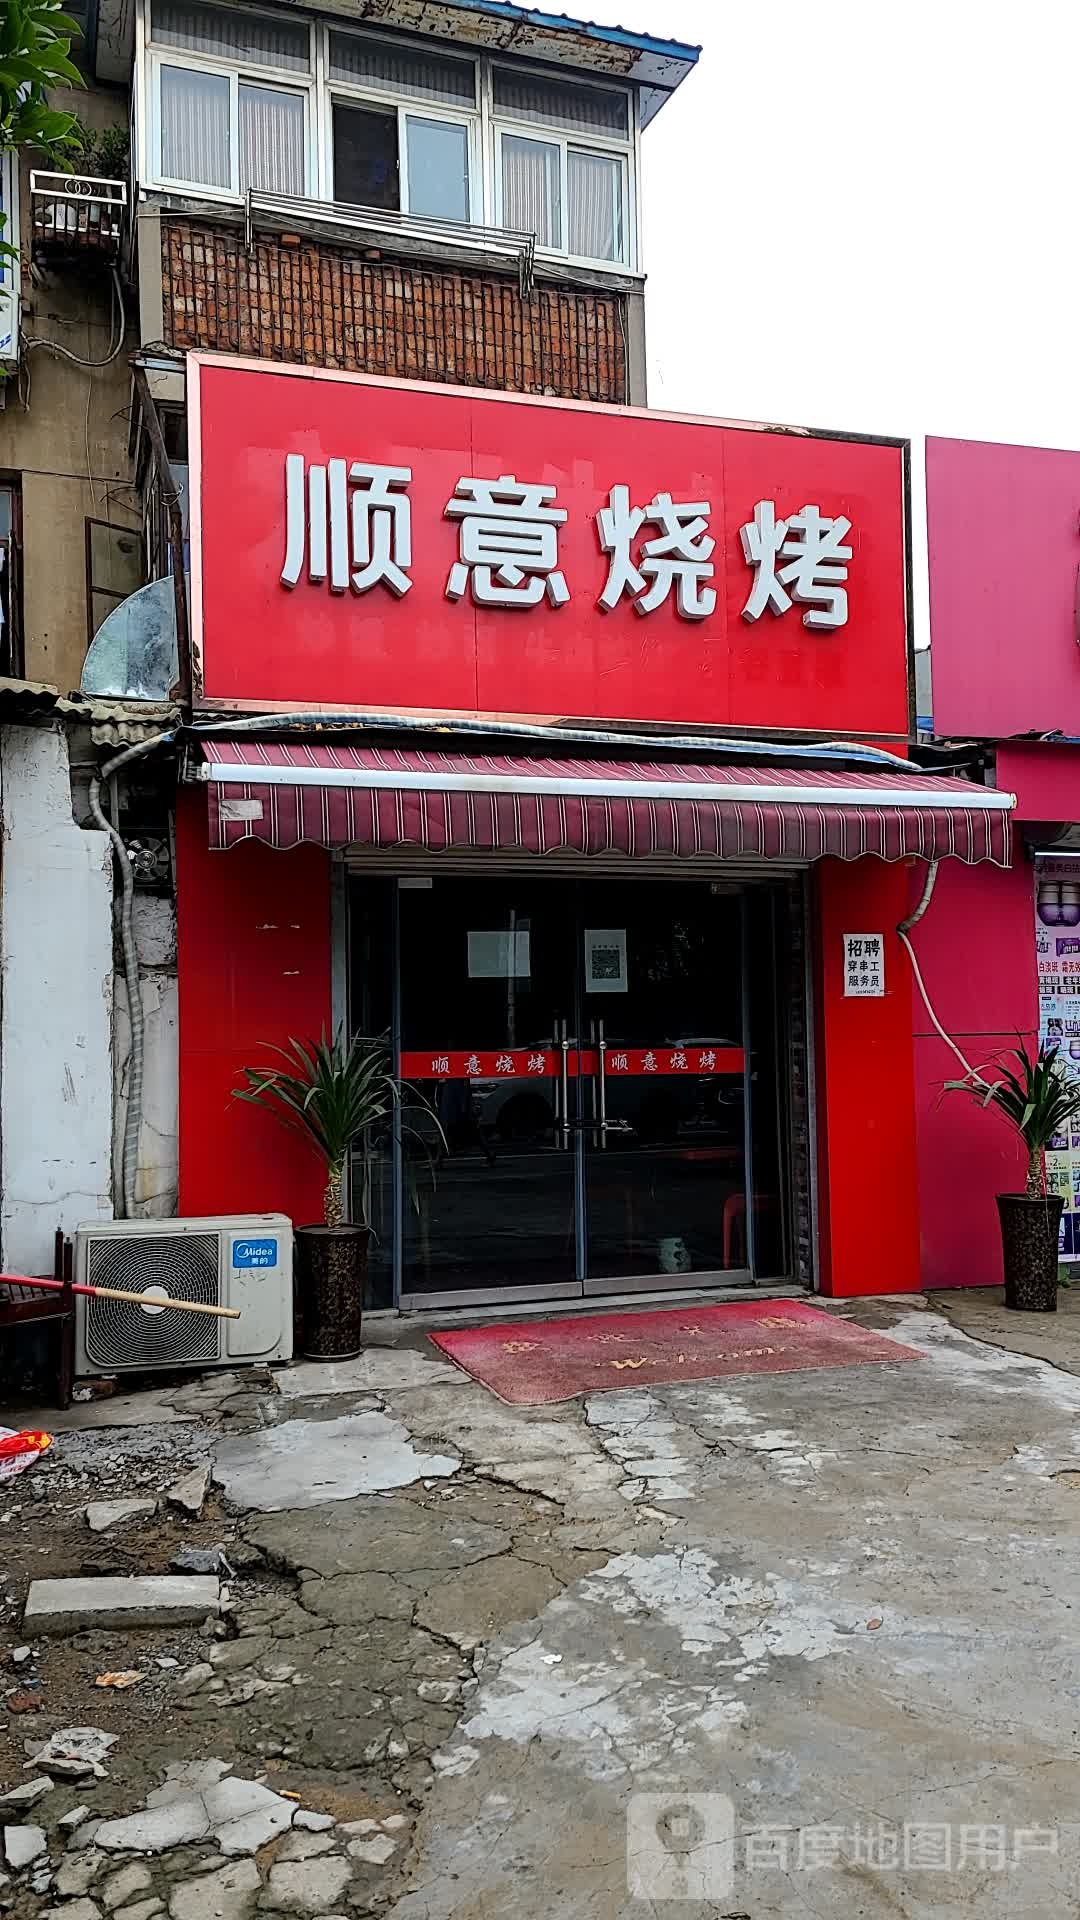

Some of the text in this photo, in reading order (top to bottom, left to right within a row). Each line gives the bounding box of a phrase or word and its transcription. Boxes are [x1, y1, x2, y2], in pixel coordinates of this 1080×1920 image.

[279, 453, 853, 629] 顺意烧烤
[847, 939, 880, 957] 招聘
[847, 960, 880, 972] 穿串工
[848, 975, 880, 987] 服务员
[431, 1054, 546, 1075] 顺意烧烤
[611, 1050, 717, 1071] 顺意烧烤
[240, 1245, 273, 1257] Midea
